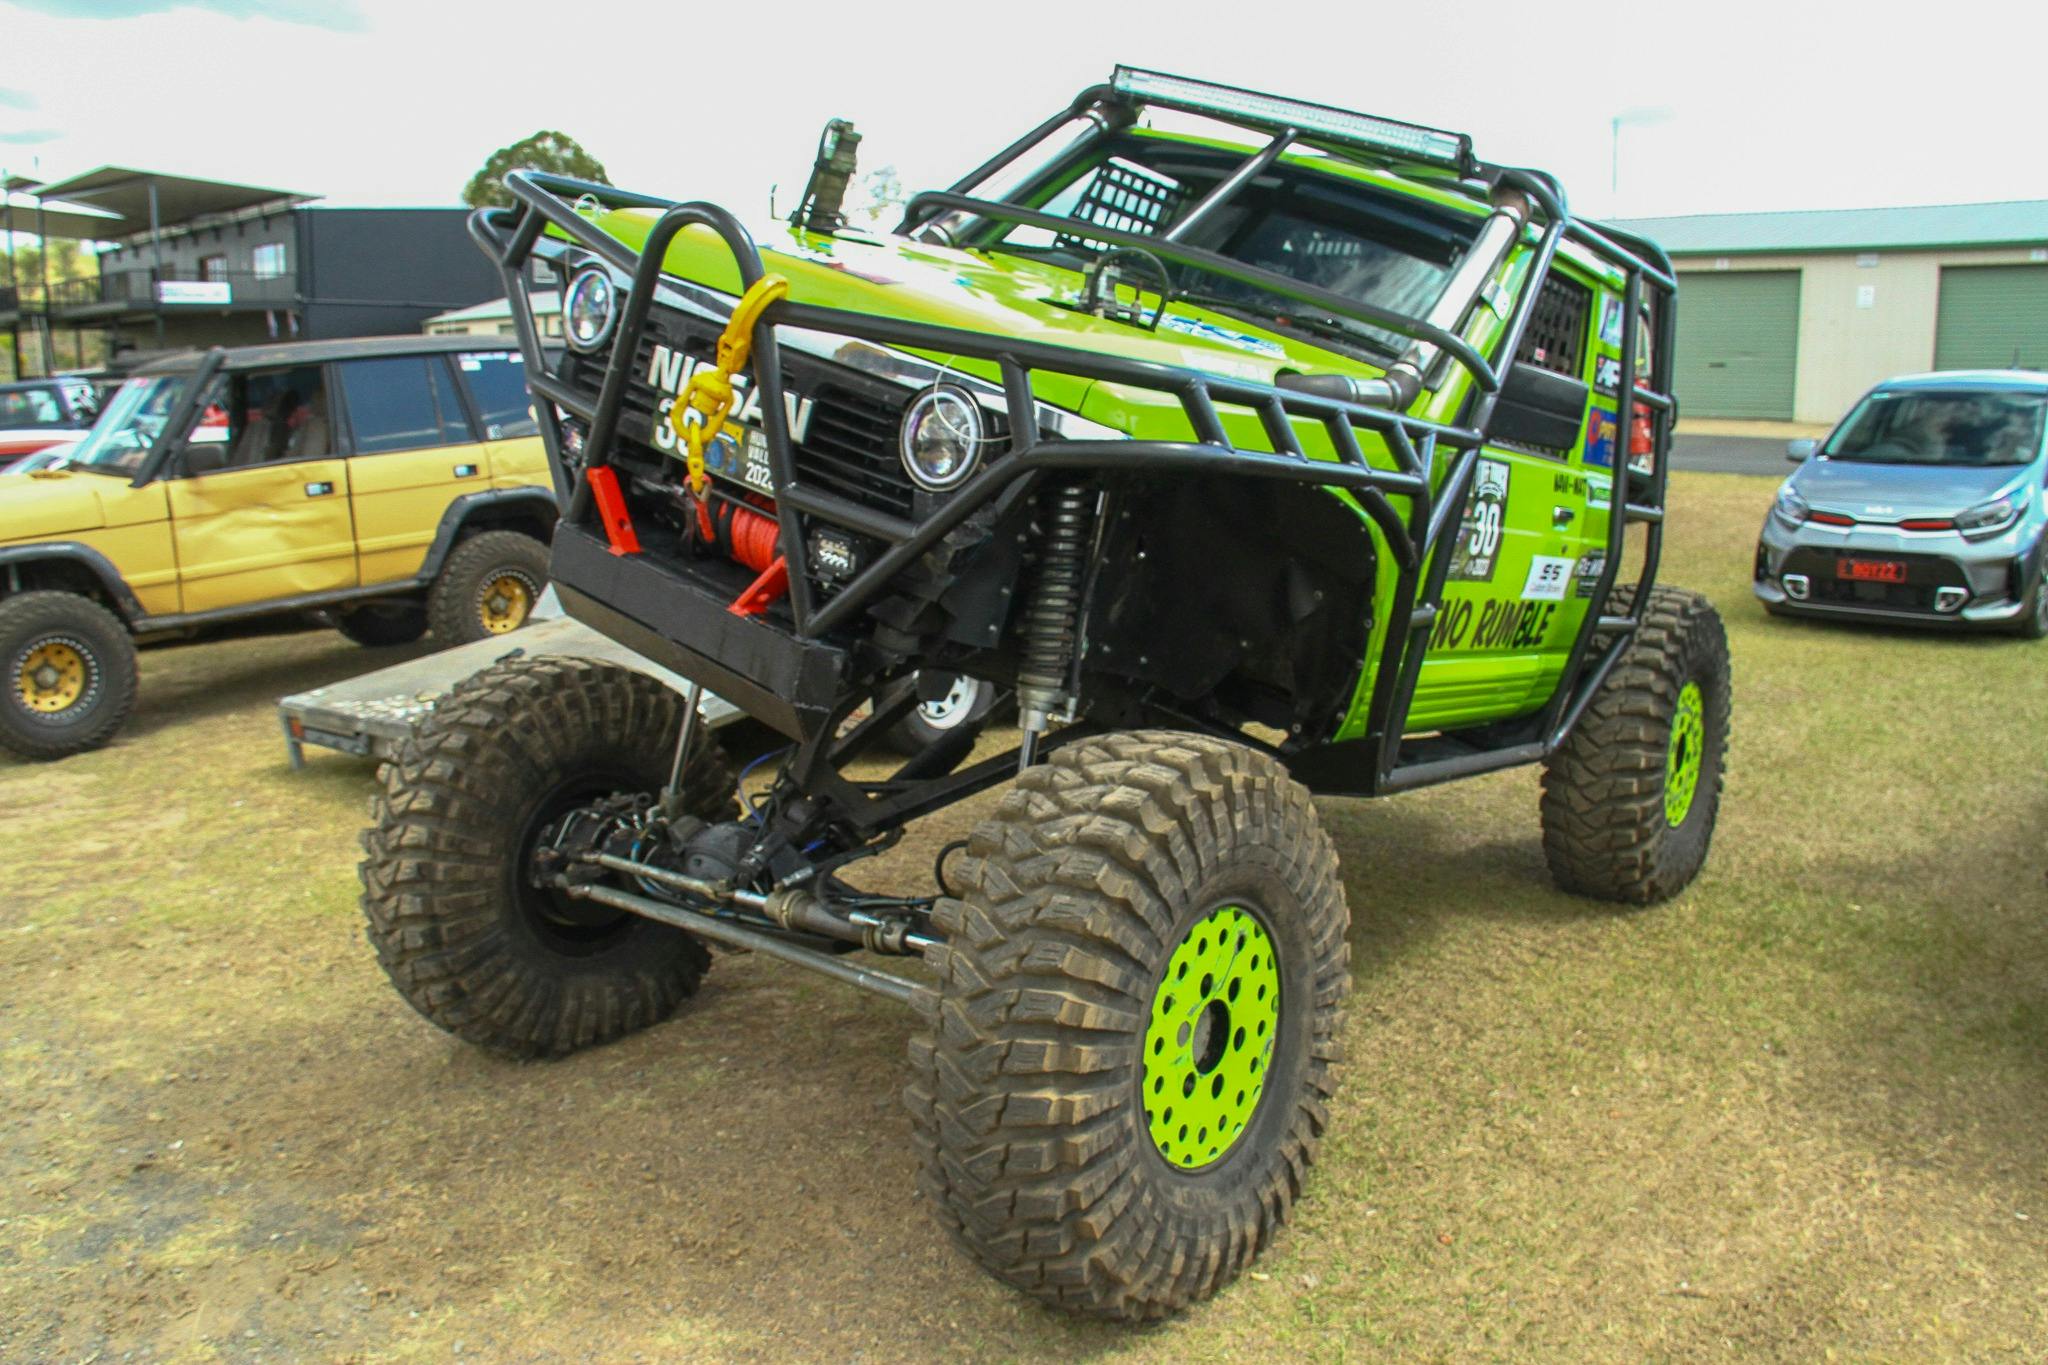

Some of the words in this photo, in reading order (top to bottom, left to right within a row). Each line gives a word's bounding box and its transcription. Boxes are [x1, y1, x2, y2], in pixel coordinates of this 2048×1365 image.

[744, 462, 774, 491] 202
[1469, 501, 1500, 556] 30
[1428, 597, 1473, 651] NO
[1470, 598, 1556, 649] RUMBLE
